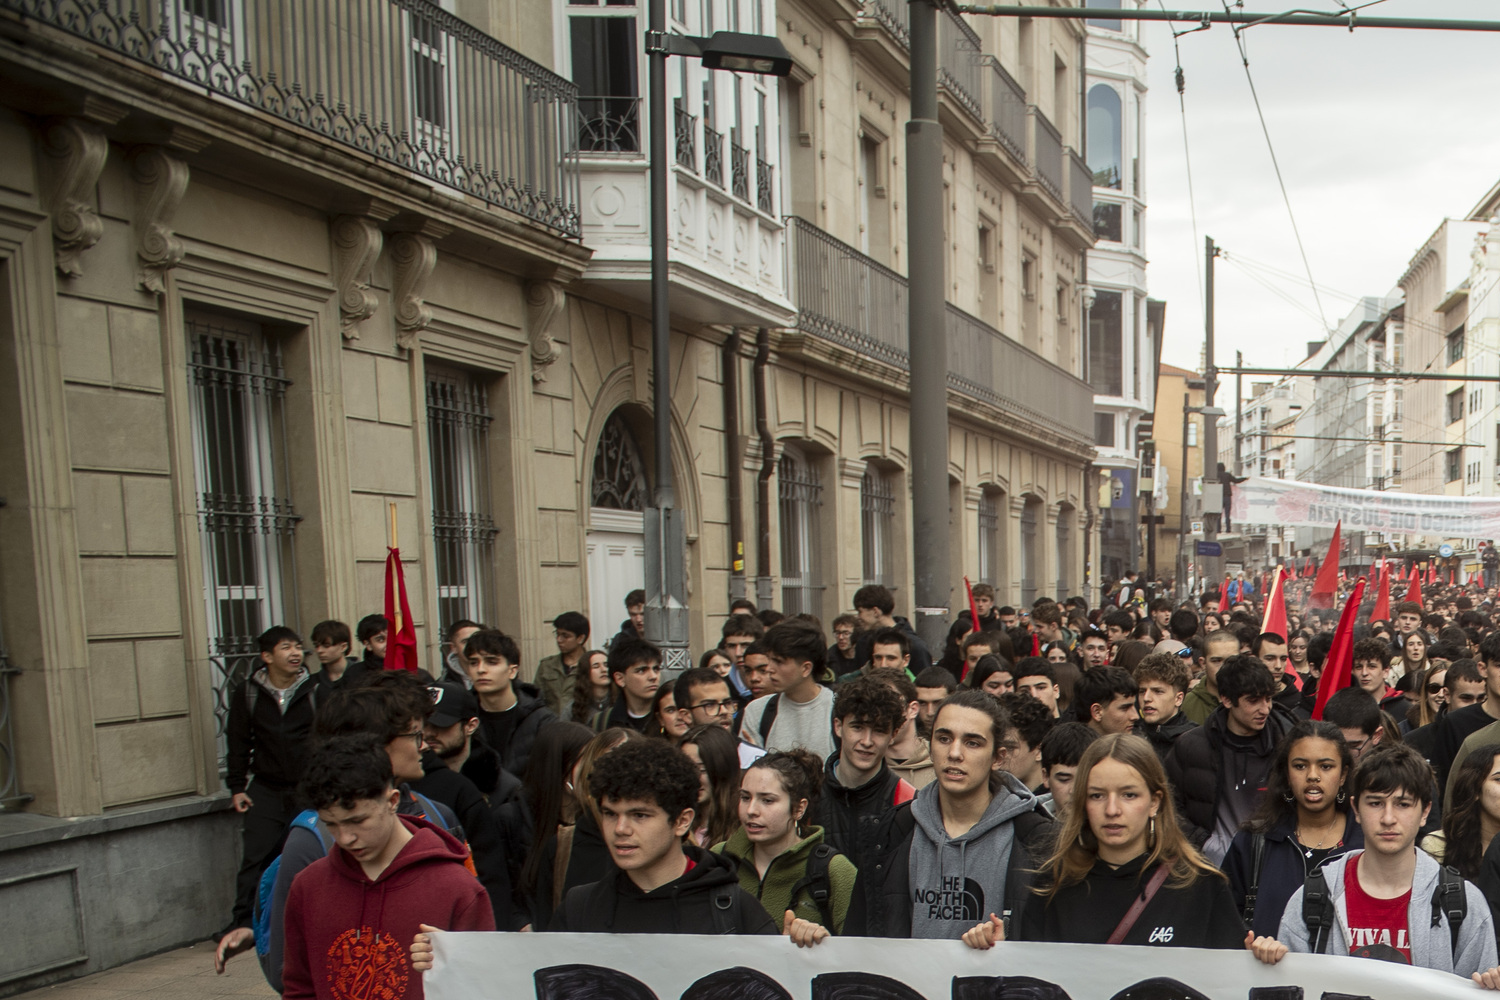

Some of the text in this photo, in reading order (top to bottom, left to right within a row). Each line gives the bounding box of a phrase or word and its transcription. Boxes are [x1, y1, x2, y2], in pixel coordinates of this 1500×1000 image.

[928, 905, 962, 920] FACE
[361, 925, 373, 933] in
[1348, 928, 1392, 948] VIVA
